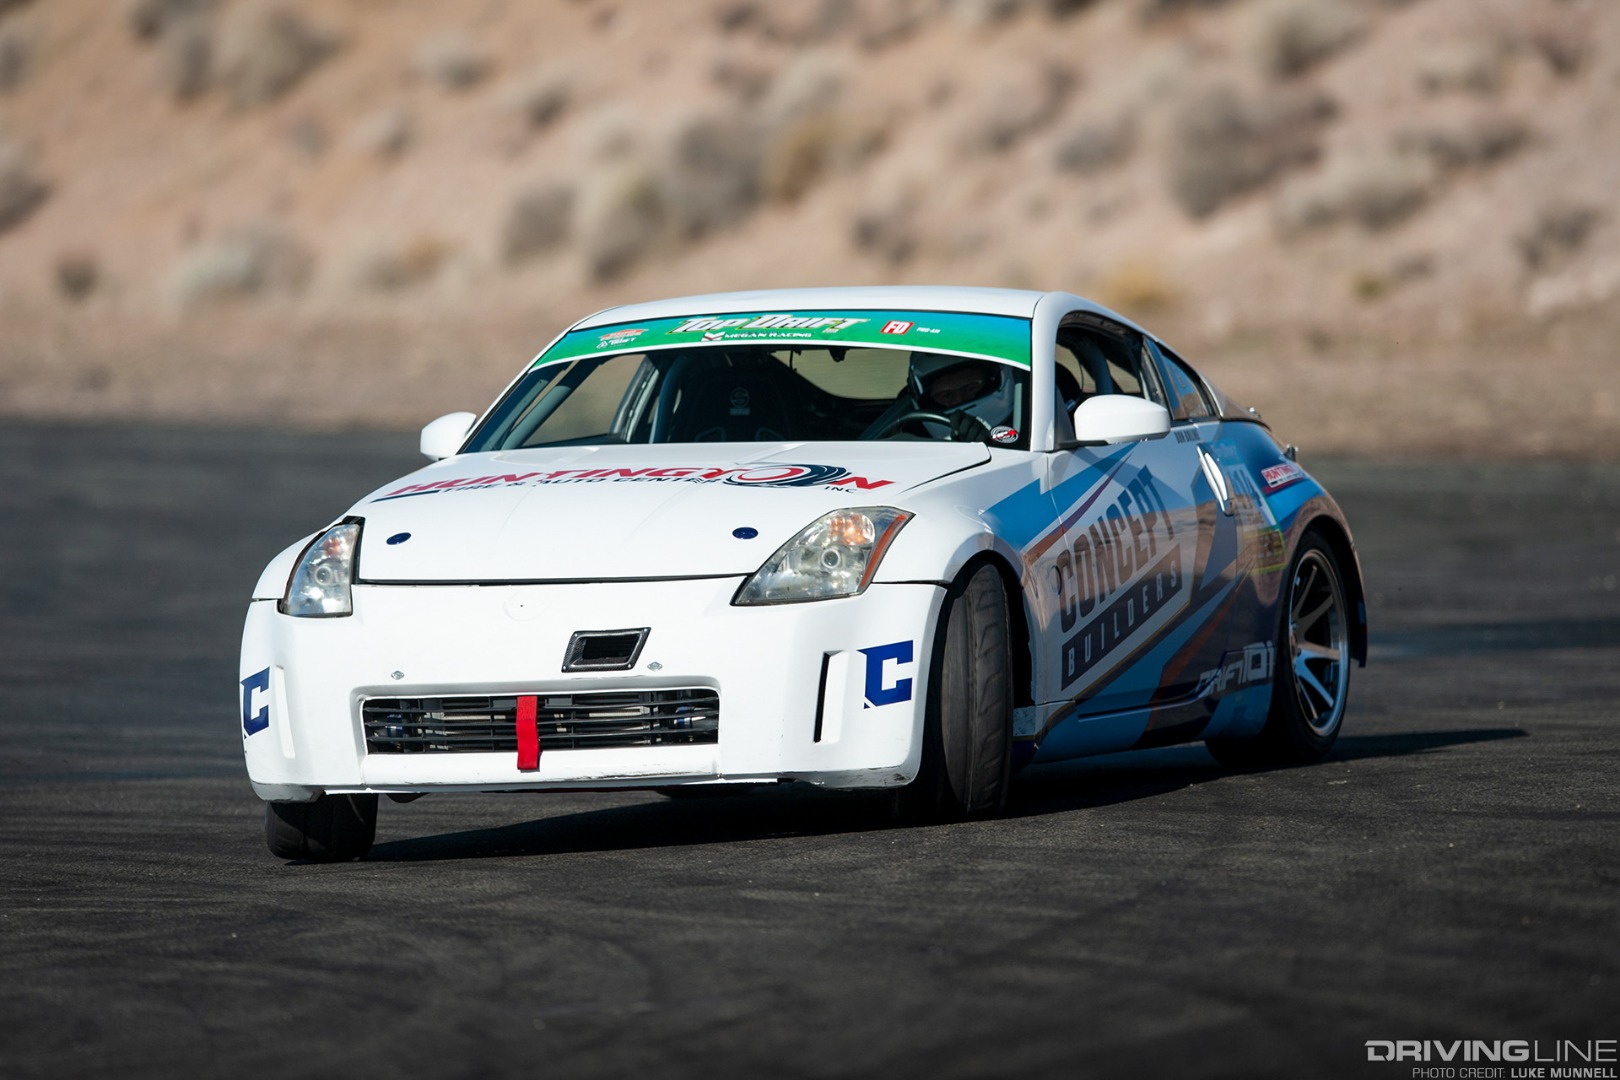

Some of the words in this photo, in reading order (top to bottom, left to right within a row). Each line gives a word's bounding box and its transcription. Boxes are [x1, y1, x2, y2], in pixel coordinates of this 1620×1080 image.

[724, 331, 767, 339] MEGAN
[768, 331, 813, 339] RACING
[1056, 464, 1175, 634] CONCEPT
[1067, 559, 1178, 678] BUILDERS
